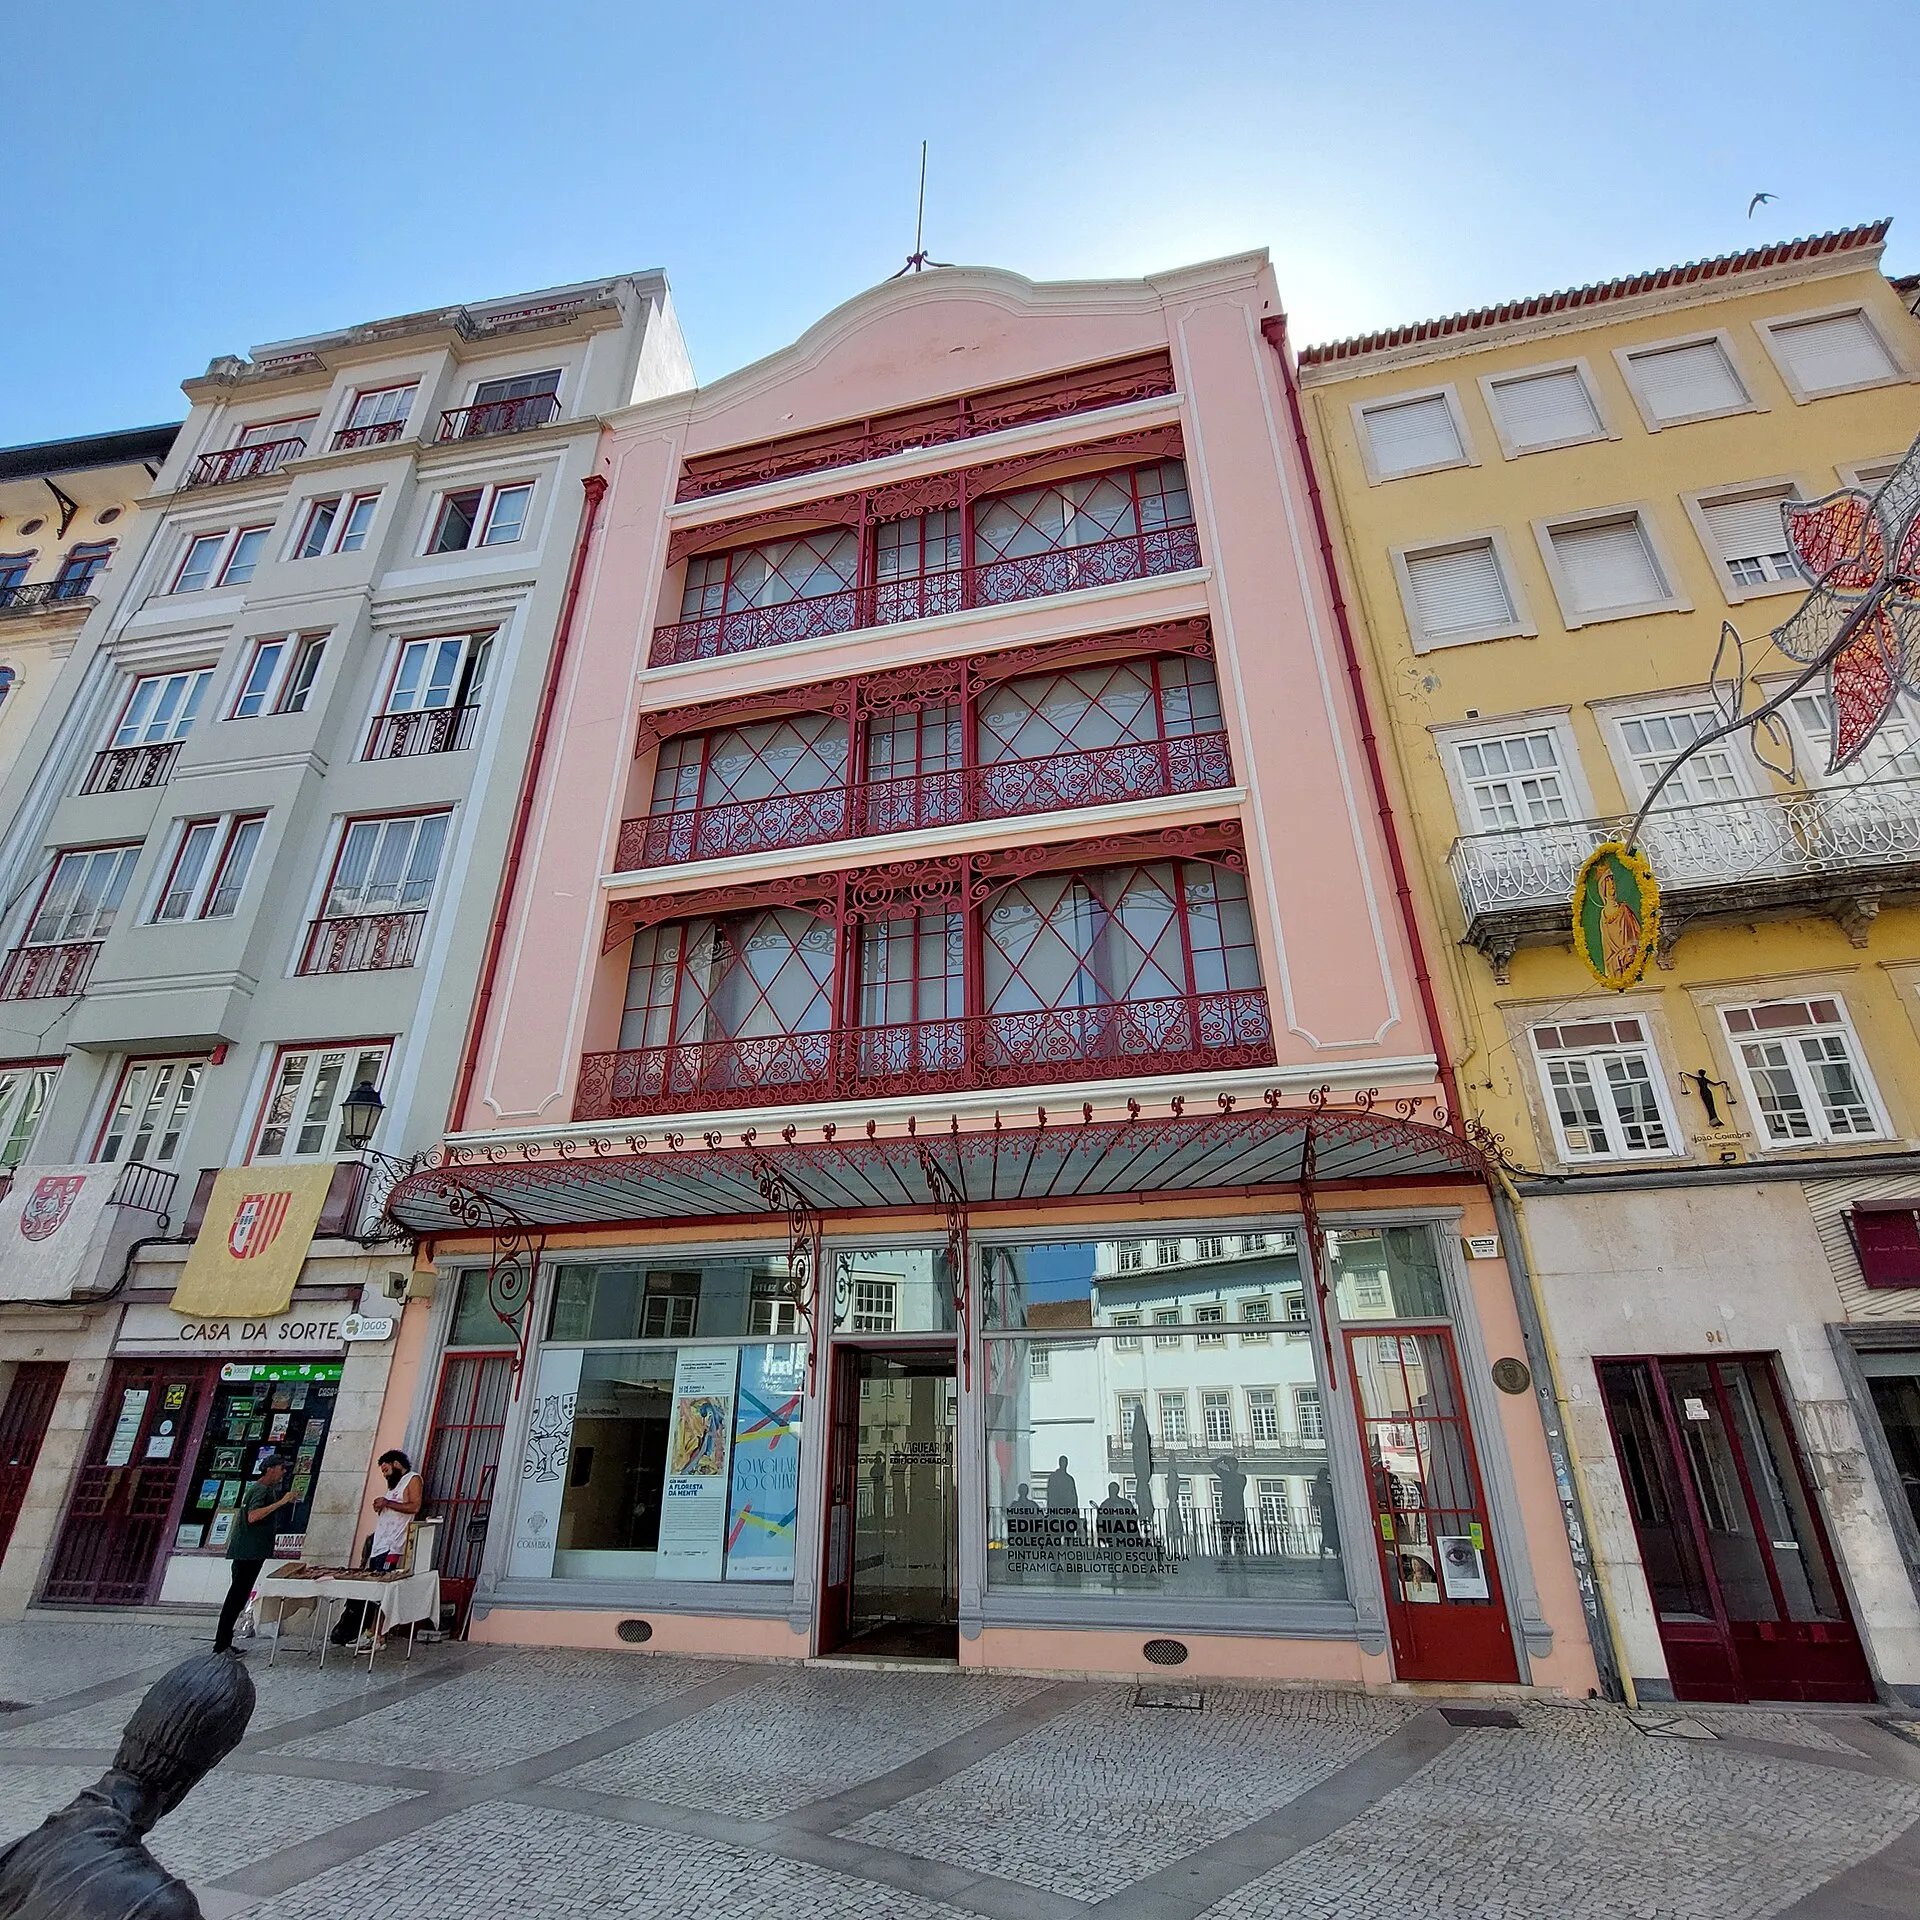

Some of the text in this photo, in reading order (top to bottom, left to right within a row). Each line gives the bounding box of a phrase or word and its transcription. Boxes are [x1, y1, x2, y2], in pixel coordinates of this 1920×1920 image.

[1714, 1130, 1752, 1140] Coimbra
[180, 1322, 338, 1340] CASA DA SORTE
[360, 1321, 387, 1332] JOGOS
[1705, 1330, 1722, 1343] 91
[893, 1443, 899, 1453] O
[902, 1442, 940, 1453] VAGUEAR
[737, 1474, 758, 1491] DO
[1008, 1515, 1077, 1533] EDIFÍCIO
[1008, 1534, 1061, 1549] COLEÇÃO
[1008, 1551, 1054, 1560] PINTURA
[1126, 1551, 1190, 1561] ESCULTURA
[1066, 1563, 1129, 1574] BIBLIOTECA
[1132, 1564, 1147, 1573] DE
[1150, 1564, 1178, 1574] ARTE
